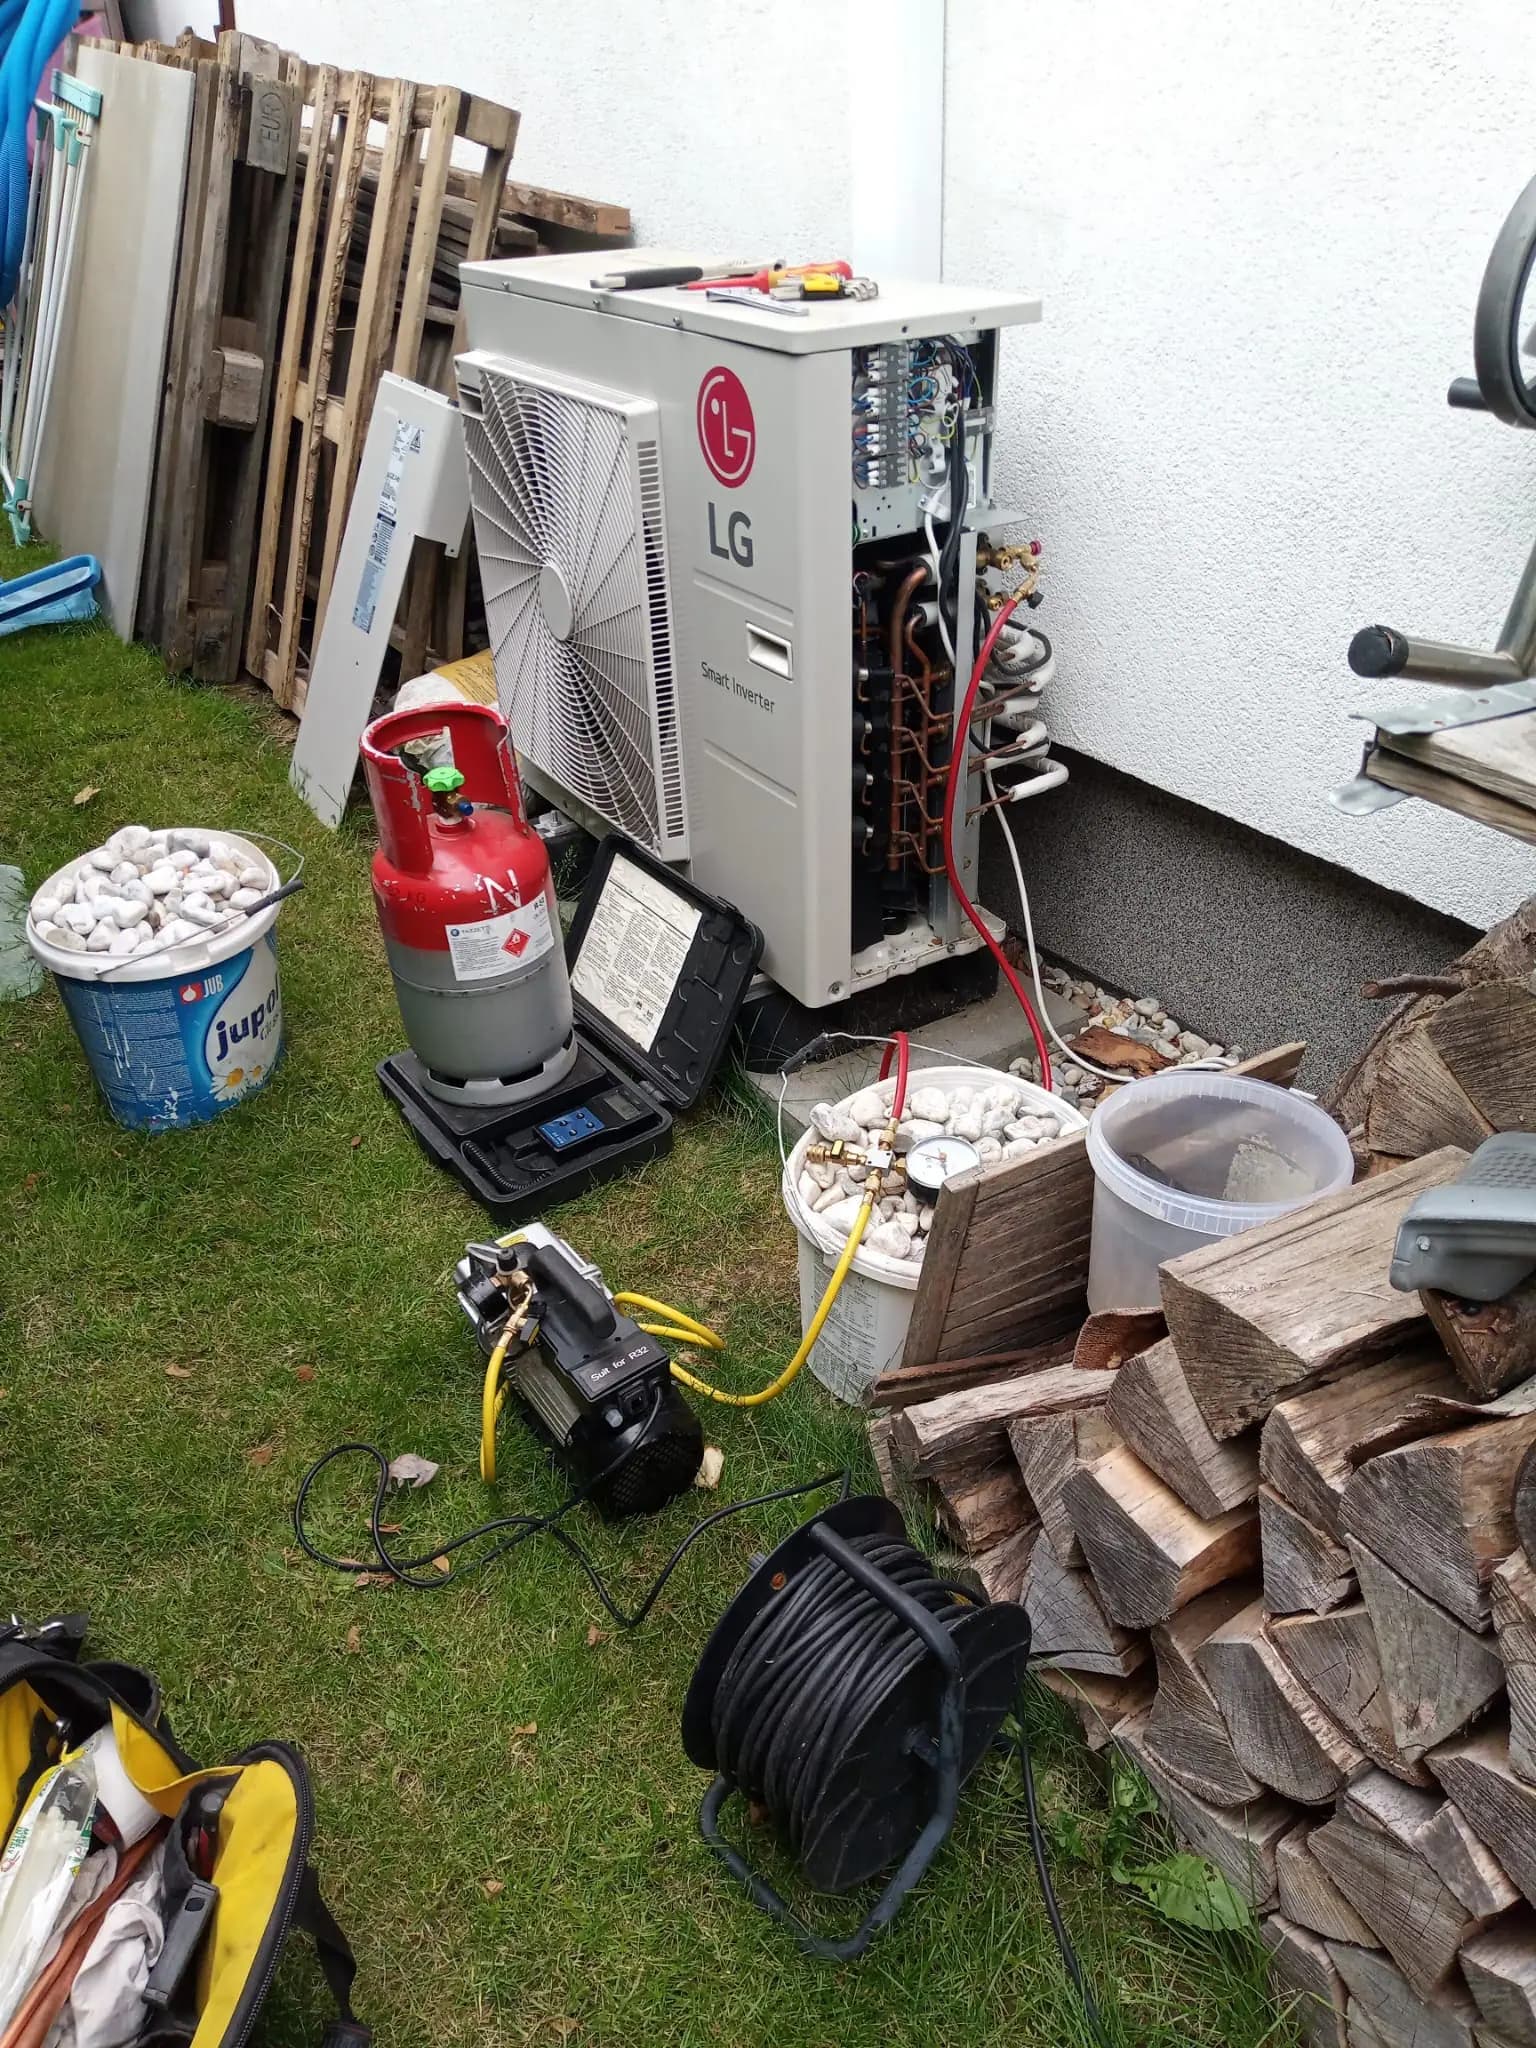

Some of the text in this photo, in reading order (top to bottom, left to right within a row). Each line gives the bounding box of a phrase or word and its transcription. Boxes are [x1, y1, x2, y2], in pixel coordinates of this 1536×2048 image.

[707, 501, 754, 568] LG
[701, 661, 775, 713] Smart Inverter
[203, 974, 224, 998] JUB
[591, 1346, 649, 1382] Suit for R32
